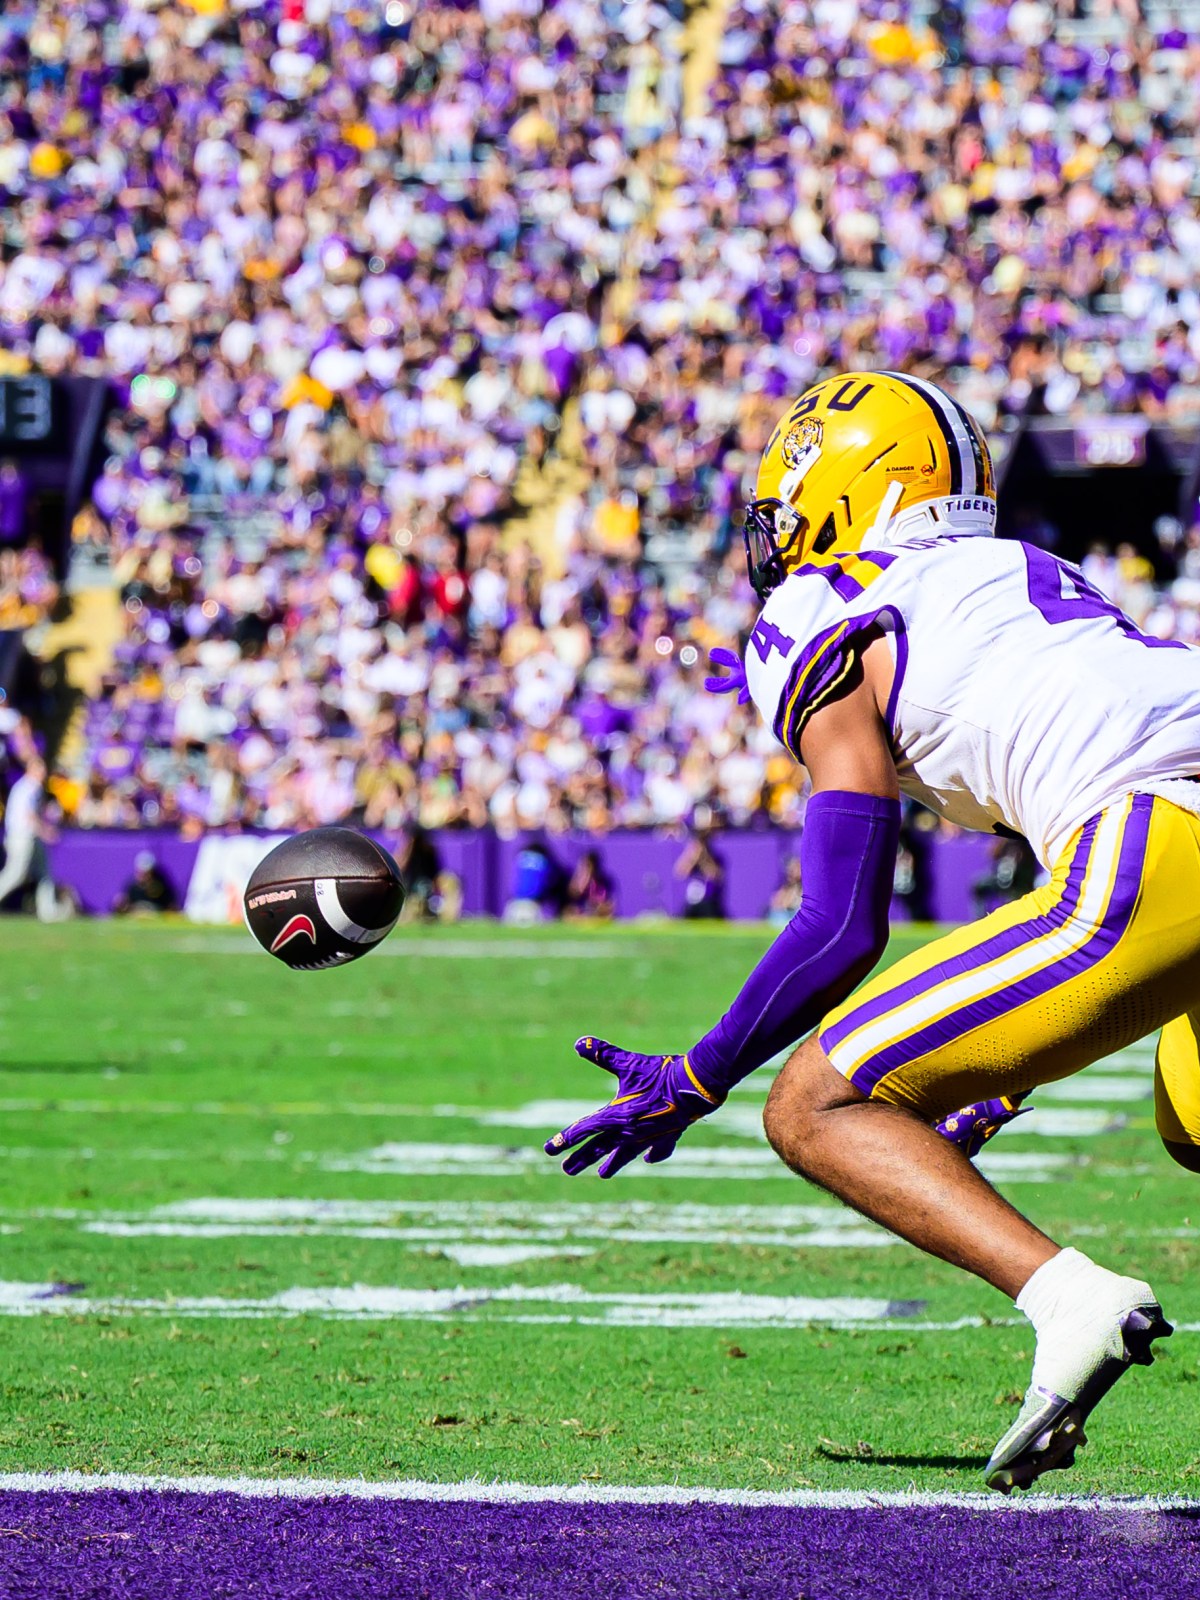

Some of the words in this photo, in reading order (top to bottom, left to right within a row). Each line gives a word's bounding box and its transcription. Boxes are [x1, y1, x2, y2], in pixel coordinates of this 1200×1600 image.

[0, 375, 52, 440] 3
[945, 499, 996, 516] TIGERS
[751, 613, 796, 665] 4
